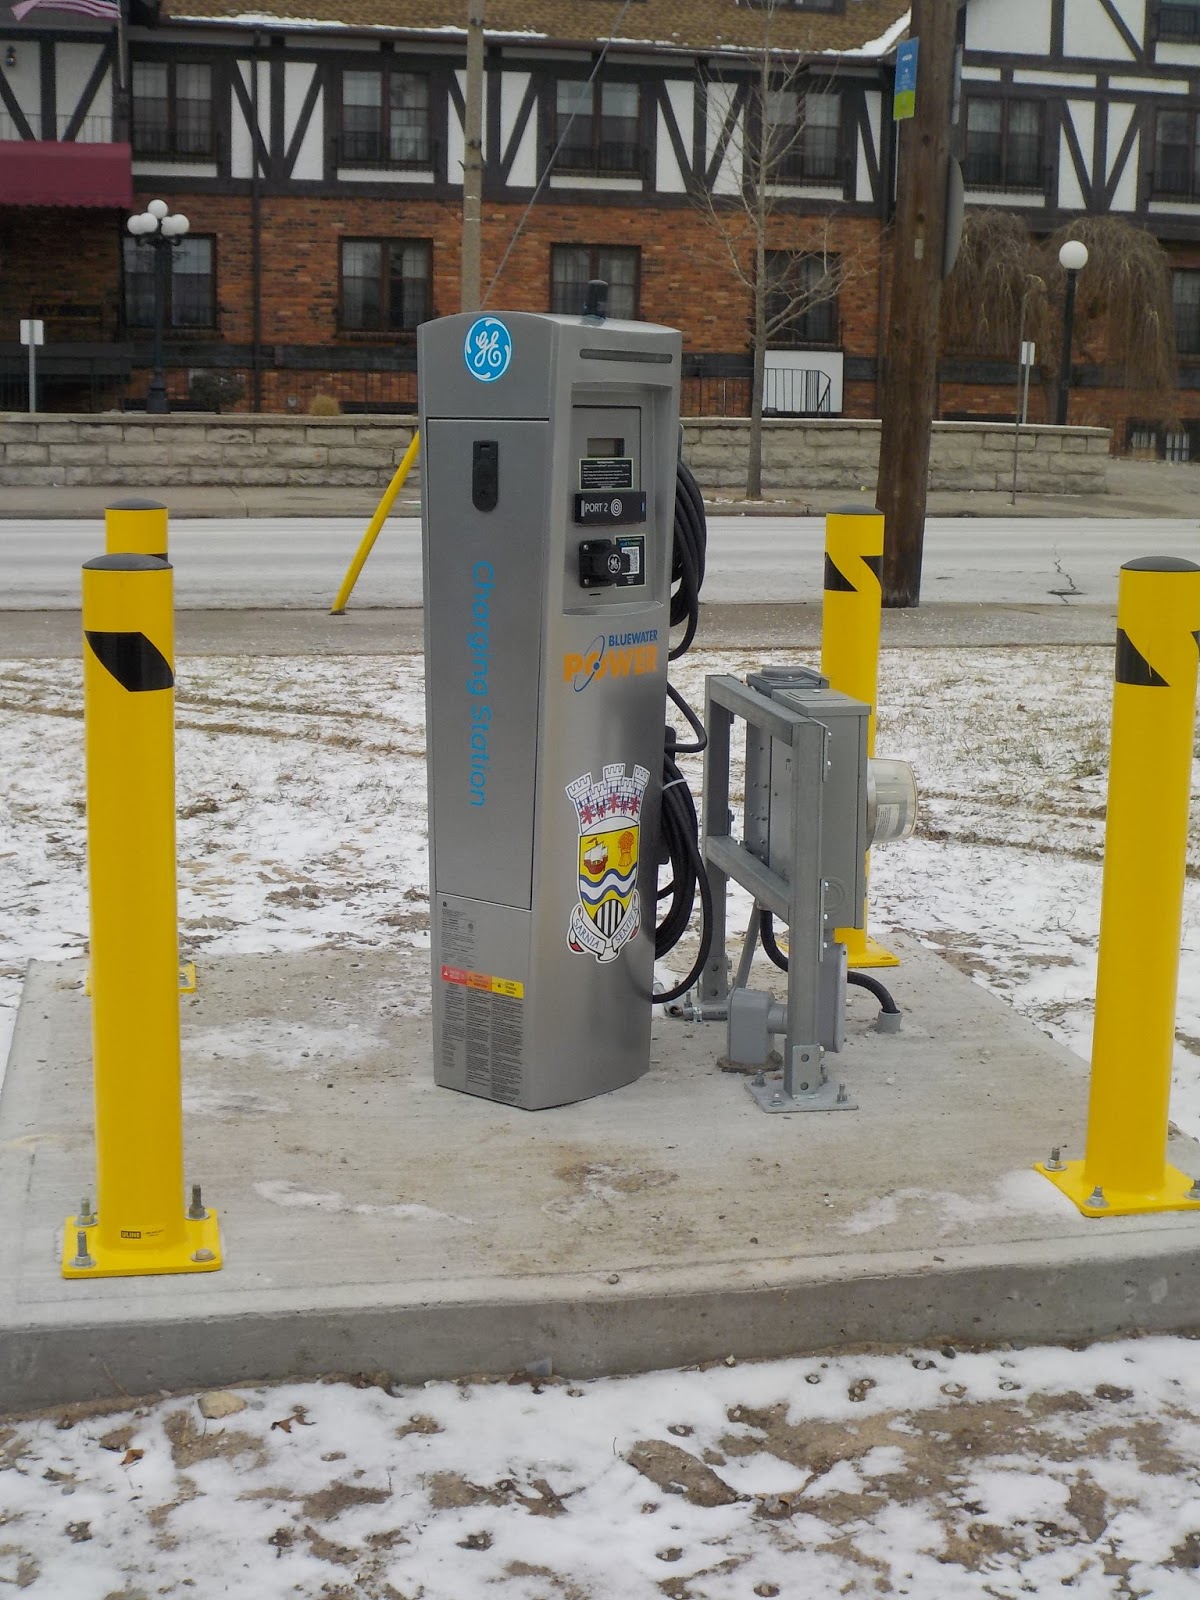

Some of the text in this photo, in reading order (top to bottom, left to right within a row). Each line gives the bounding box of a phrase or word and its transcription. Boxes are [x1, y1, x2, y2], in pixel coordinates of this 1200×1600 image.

[585, 503, 609, 512] PORT 2
[608, 629, 658, 647] BLUEWATER
[563, 644, 658, 683] POWER
[465, 560, 496, 807] Charging Station
[573, 918, 600, 949] SARNIA
